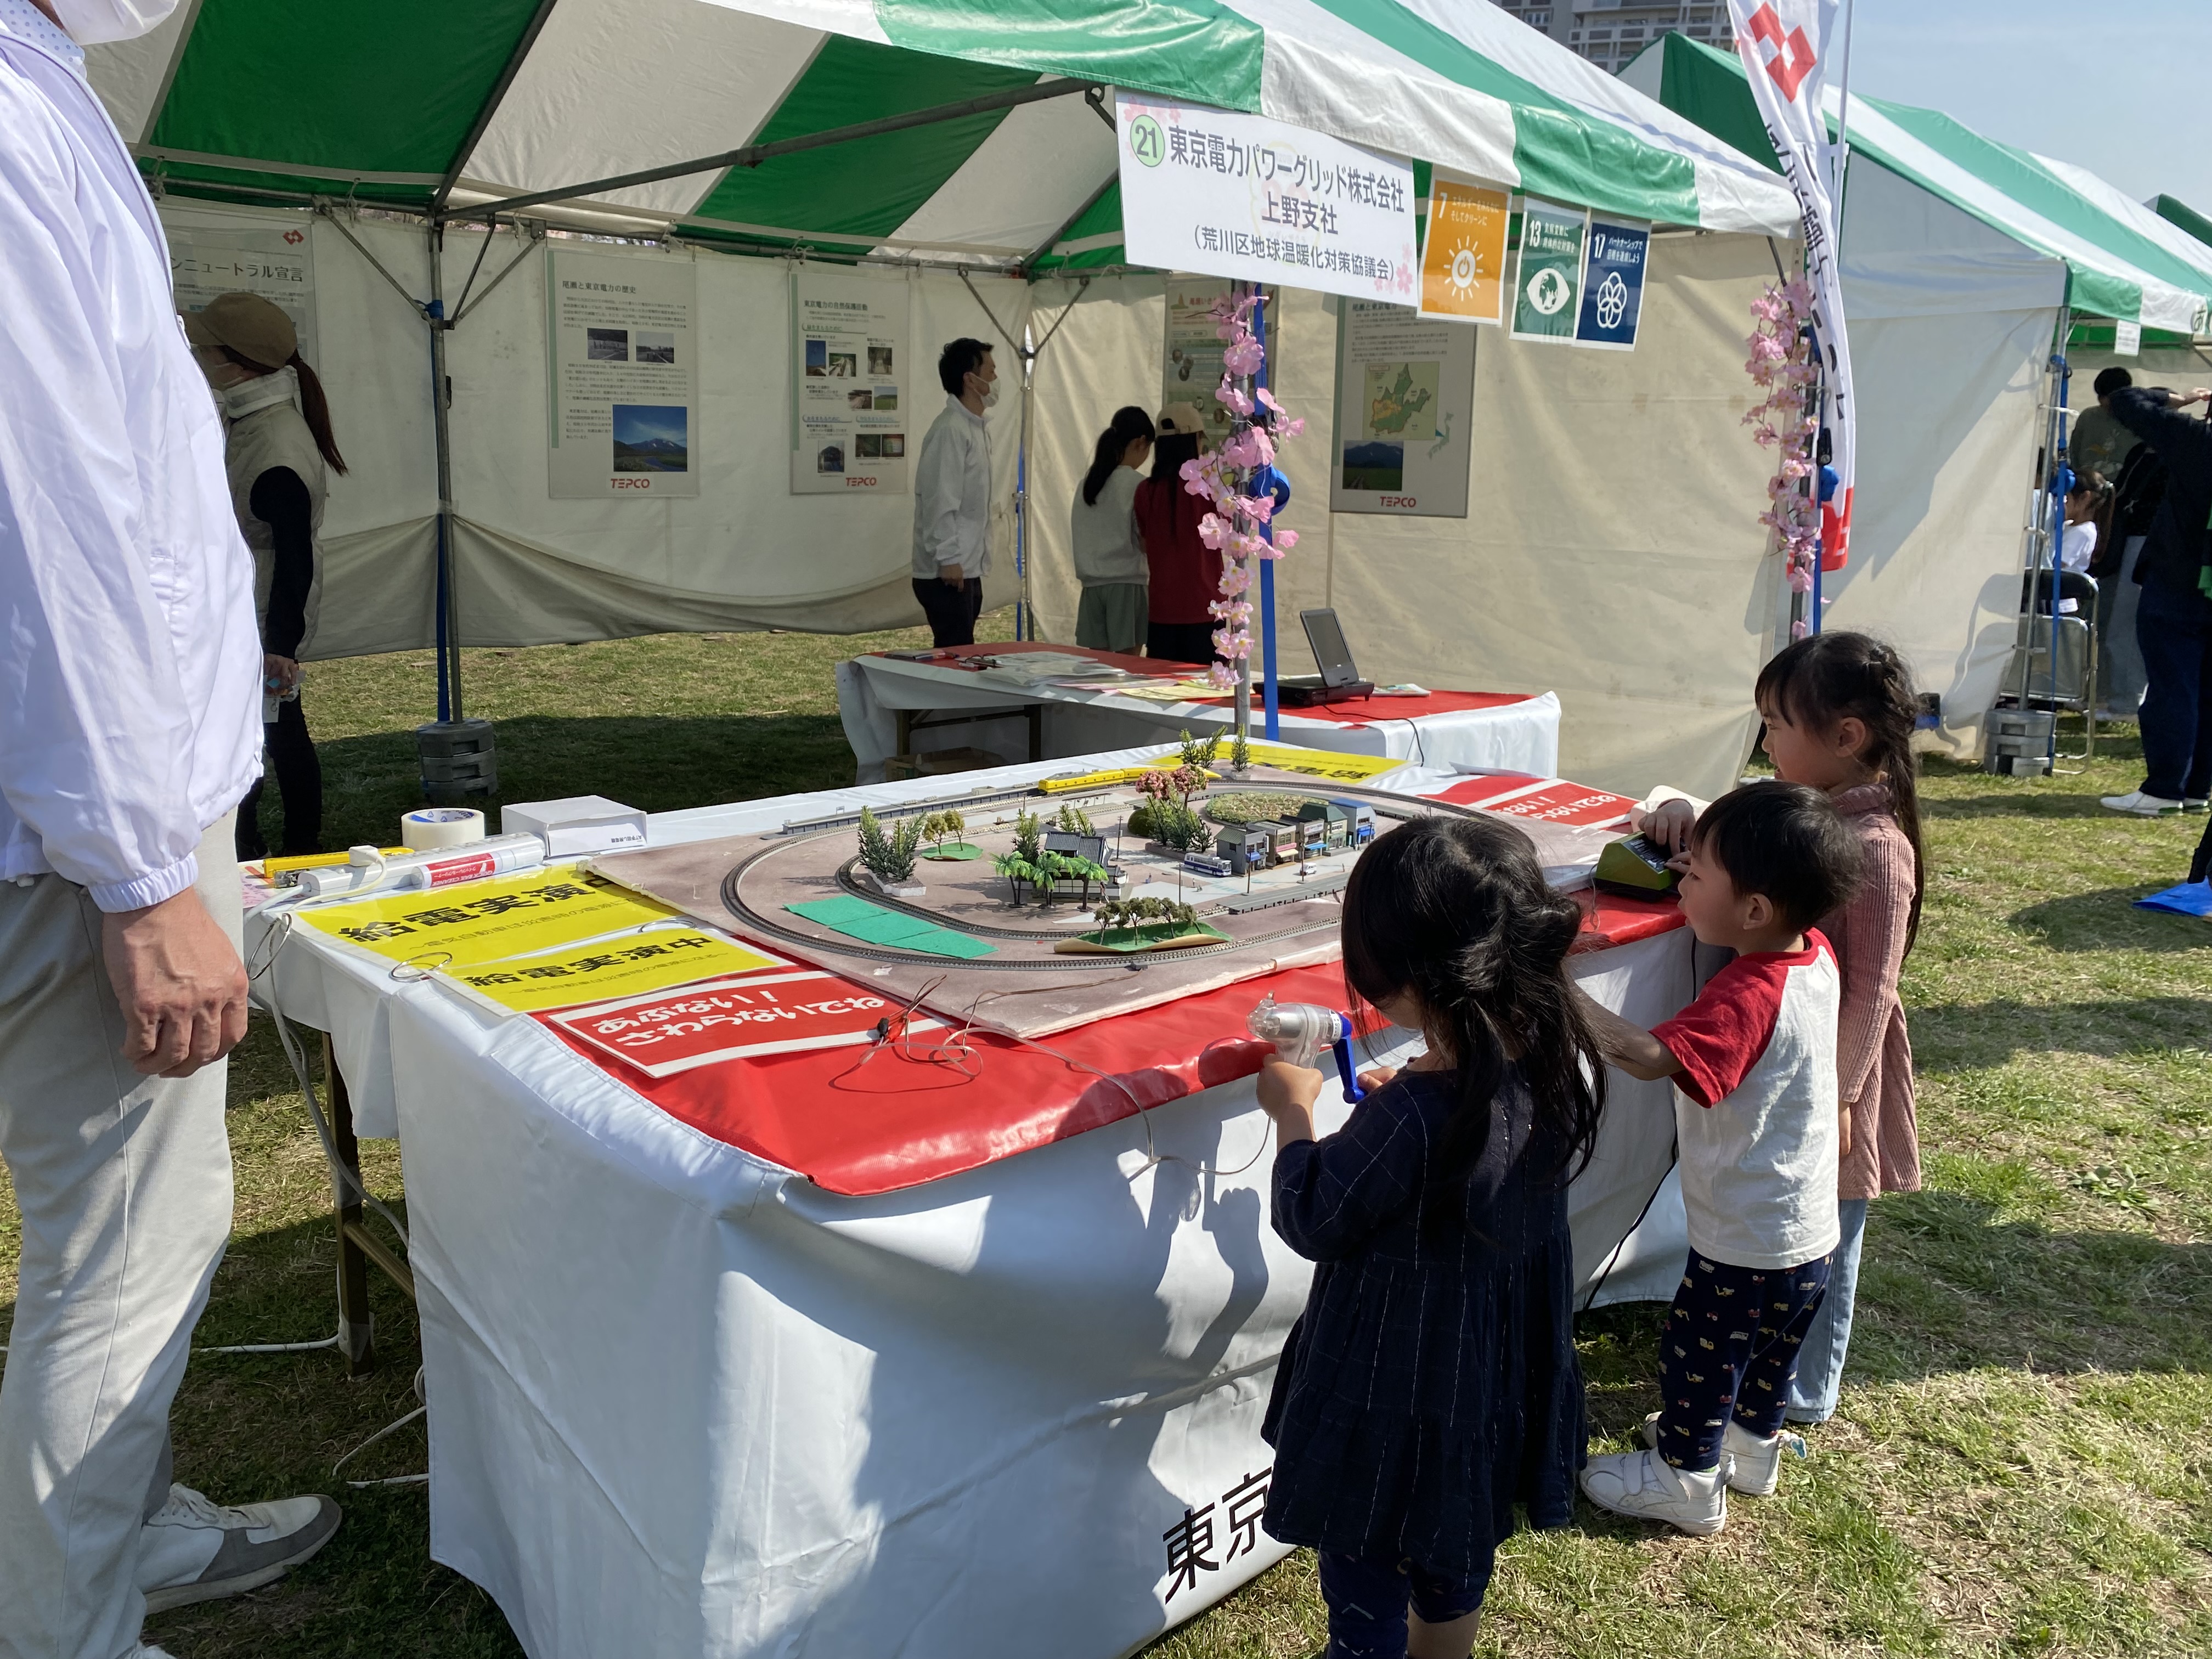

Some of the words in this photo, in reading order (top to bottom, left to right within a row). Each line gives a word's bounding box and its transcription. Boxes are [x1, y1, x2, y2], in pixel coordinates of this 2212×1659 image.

[1135, 124, 1158, 159] 21
[1169, 125, 1404, 213] 東京電力パワーグリッド株式会社
[1261, 190, 1338, 235] 上野支社
[1439, 193, 1447, 219] 7
[1451, 210, 1488, 226] そしてクリーンに
[1529, 219, 1541, 247] 13
[1594, 233, 1606, 258] 17
[562, 280, 636, 294] 尾瀬と東京電力の歴史
[611, 478, 650, 489] TEPCO
[845, 477, 877, 487] TEPCO
[1379, 496, 1417, 508] TEPCO
[464, 937, 714, 987] 給電実演中
[592, 990, 779, 1035] あぶない！
[615, 996, 886, 1047] さわらないでね
[1163, 1466, 1272, 1605] 東京
